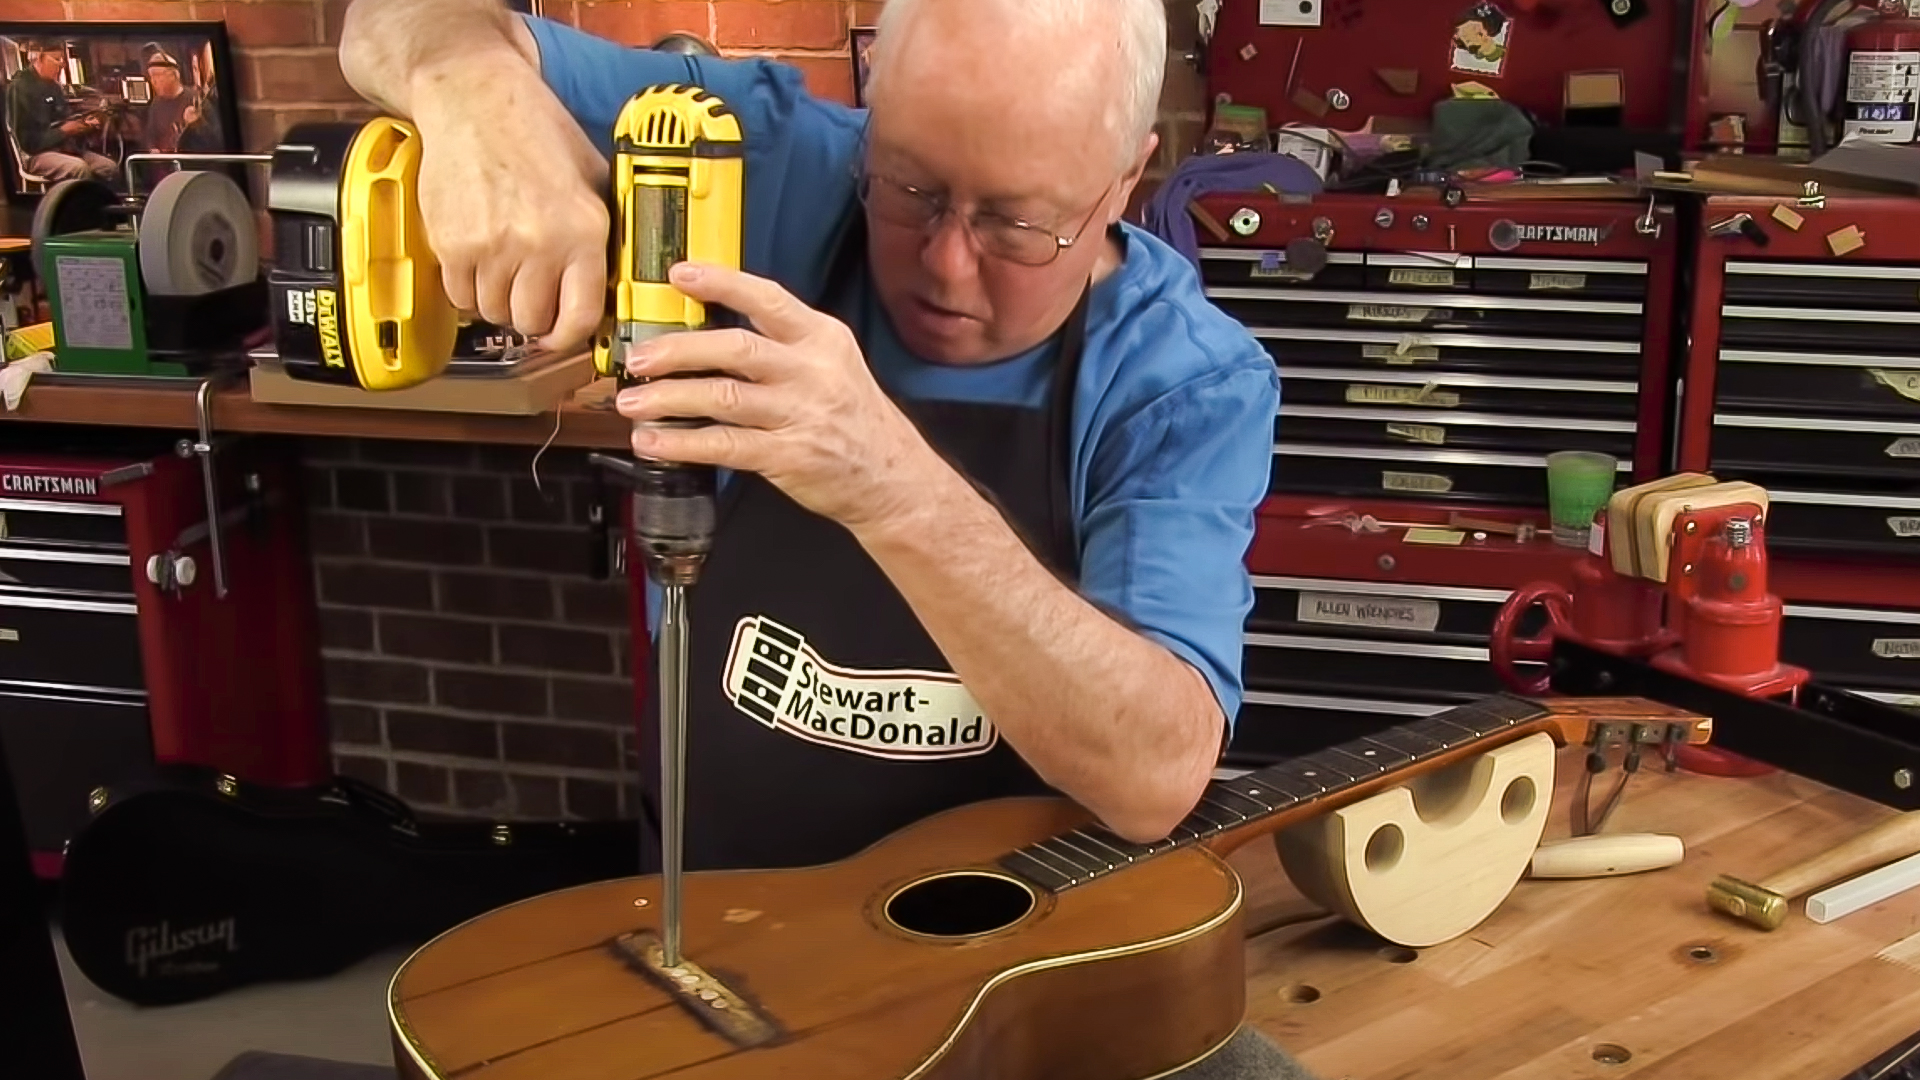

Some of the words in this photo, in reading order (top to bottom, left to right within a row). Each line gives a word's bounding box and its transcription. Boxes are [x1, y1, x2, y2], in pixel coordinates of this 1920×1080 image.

[1513, 224, 1598, 242] RAFTSMAN
[304, 288, 317, 326] 18V
[2, 473, 97, 495] CRAFTSMAN
[797, 661, 930, 713] Stewart-
[785, 689, 983, 746] MacDonald
[126, 916, 238, 978] Gibson
